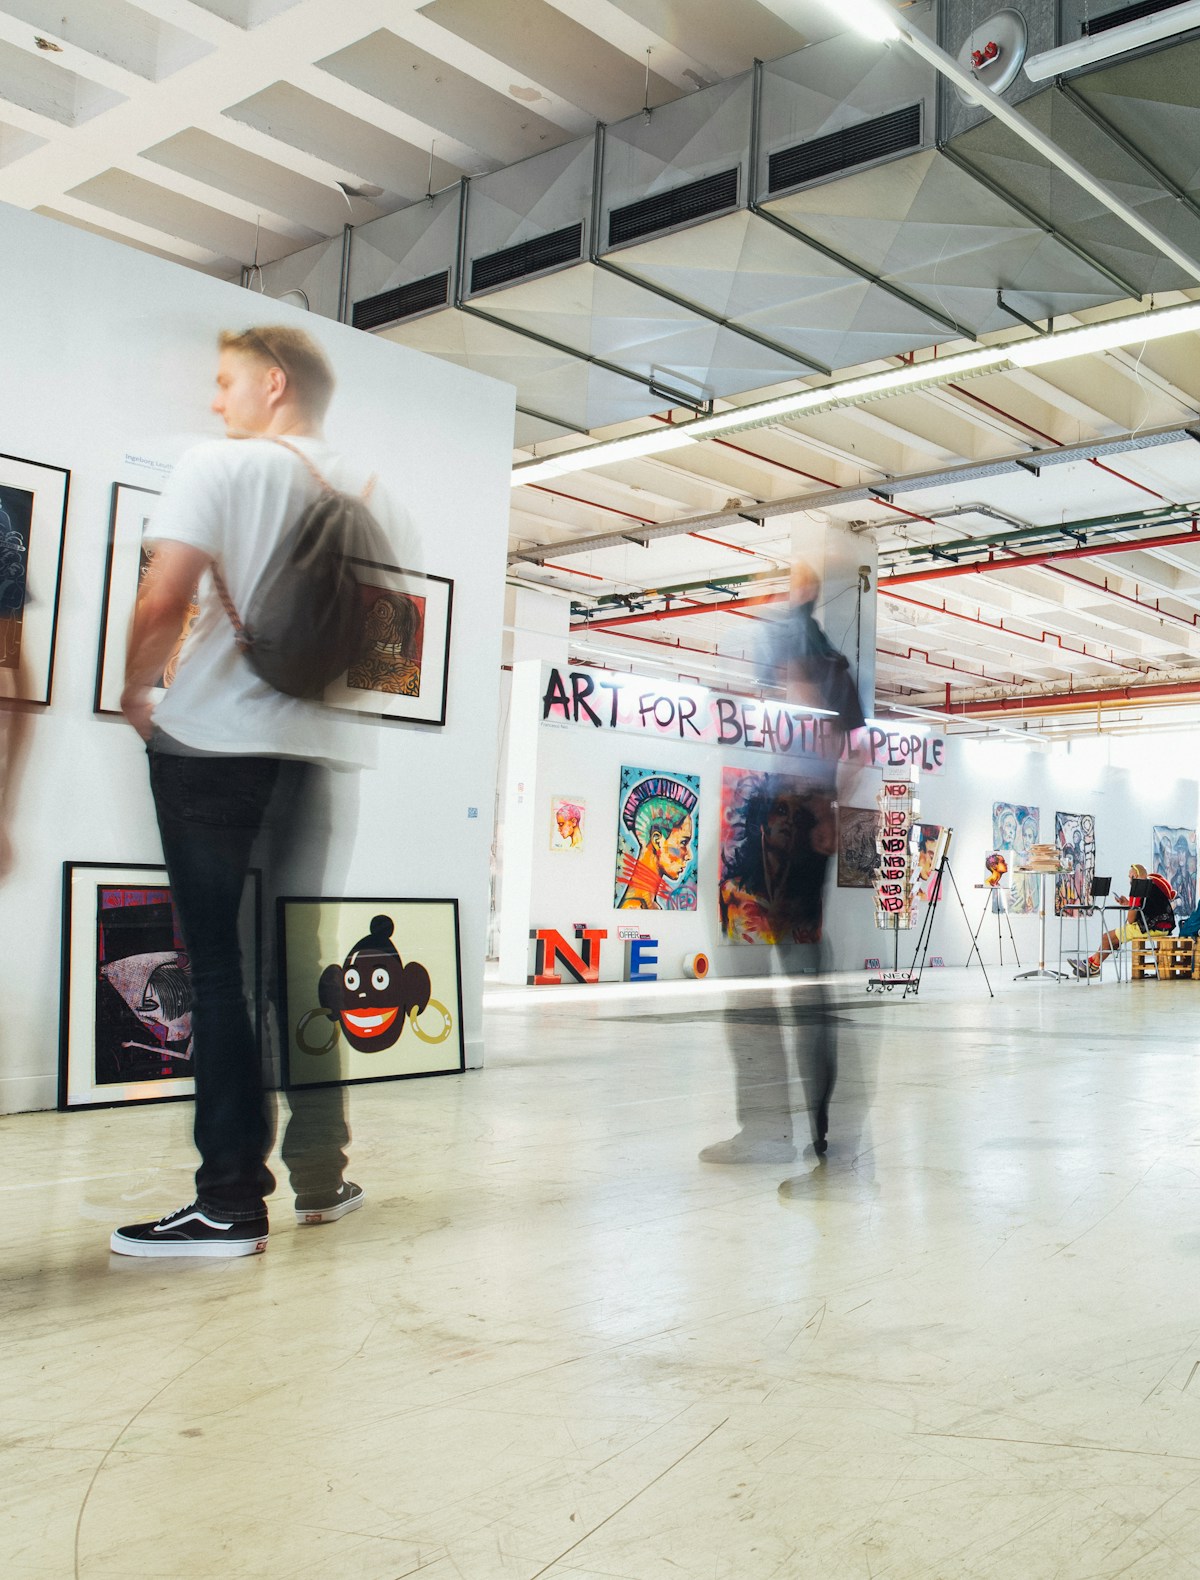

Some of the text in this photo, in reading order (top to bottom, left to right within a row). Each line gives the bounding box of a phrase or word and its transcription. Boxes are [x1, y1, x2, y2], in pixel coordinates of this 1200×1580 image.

[543, 668, 623, 728] ART
[639, 692, 701, 737] FOR
[870, 727, 944, 770] PEOPLE
[885, 784, 907, 796] NEO
[885, 811, 906, 826] NEO
[882, 839, 905, 852] NEO
[883, 856, 905, 868] NEO
[881, 869, 904, 880] NEO
[881, 884, 902, 895] NEO
[879, 897, 903, 911] NEO
[883, 972, 910, 980] NEO
